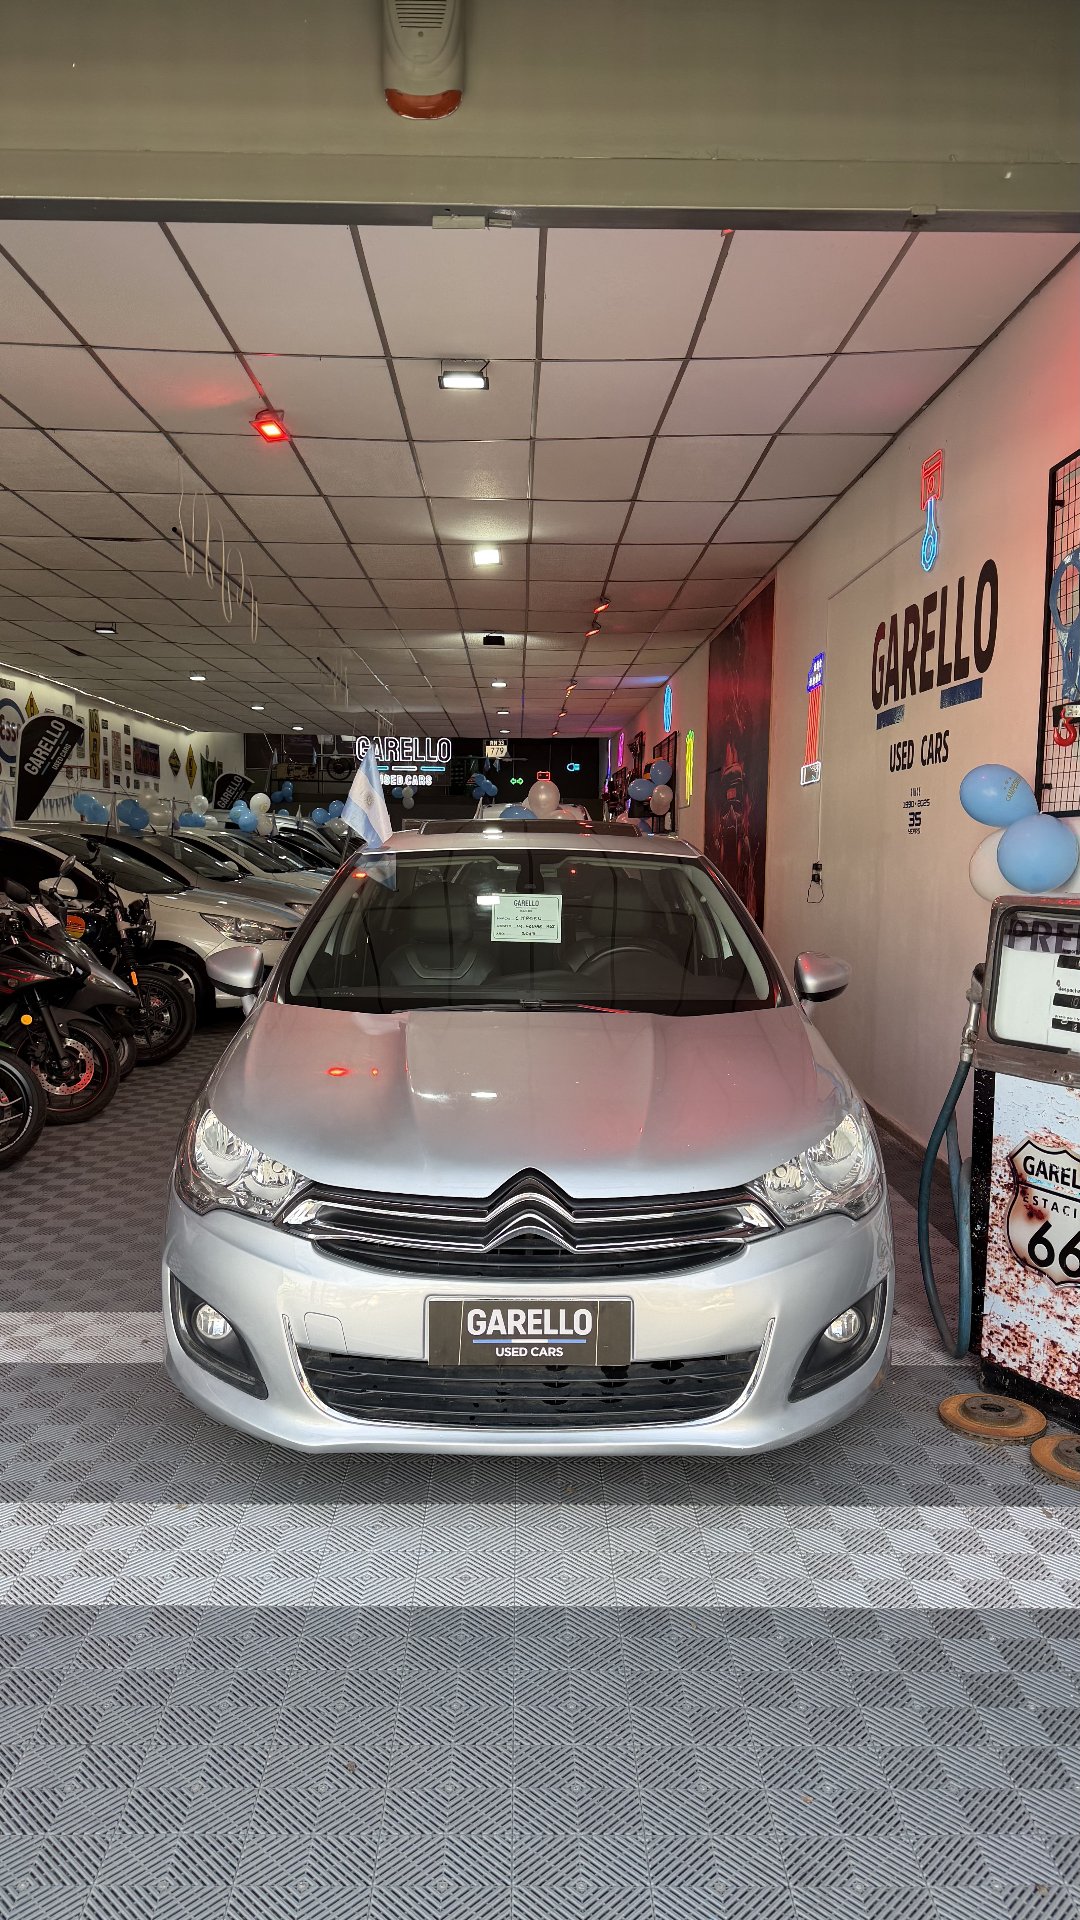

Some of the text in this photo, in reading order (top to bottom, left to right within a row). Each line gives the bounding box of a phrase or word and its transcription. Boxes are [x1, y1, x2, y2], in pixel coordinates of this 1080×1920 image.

[872, 559, 998, 710] GARELLO
[24, 720, 66, 776] GARELLO
[356, 736, 452, 763] GARELLO
[890, 729, 949, 773] USED CARS
[218, 775, 243, 808] GARELLO
[404, 774, 433, 786] CARS
[908, 811, 922, 827] 35
[513, 899, 540, 907] GARELLO
[1008, 920, 1080, 954] PRE
[1028, 1220, 1080, 1278] 66
[467, 1308, 593, 1336] GARELLO
[495, 1346, 564, 1357] USED CARS
